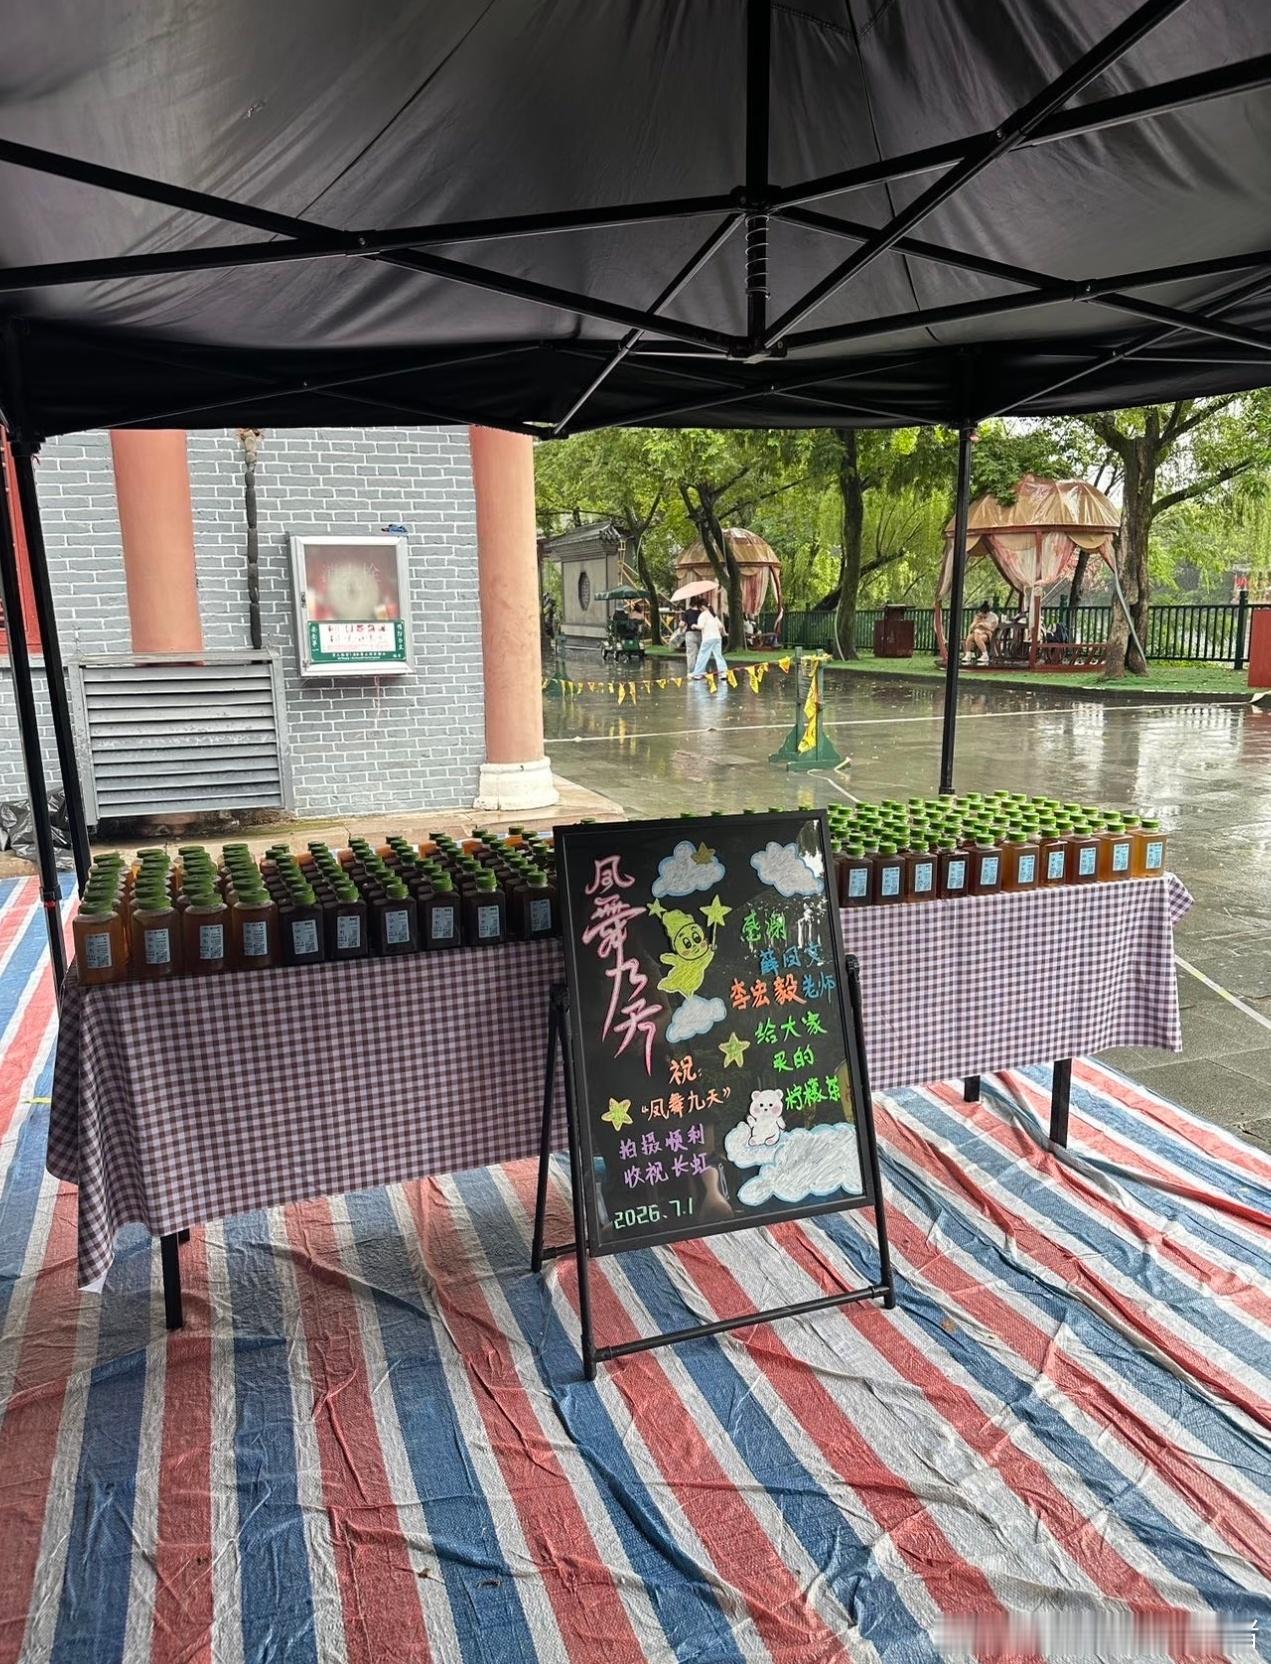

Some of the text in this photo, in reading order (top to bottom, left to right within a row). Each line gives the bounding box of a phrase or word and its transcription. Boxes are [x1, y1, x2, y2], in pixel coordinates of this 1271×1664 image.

[730, 973, 836, 1009] 李宏毅老师
[755, 1011, 828, 1044] 给大家
[618, 1123, 705, 1160] 拍摄顺利
[624, 1152, 712, 1189] 收视长虹
